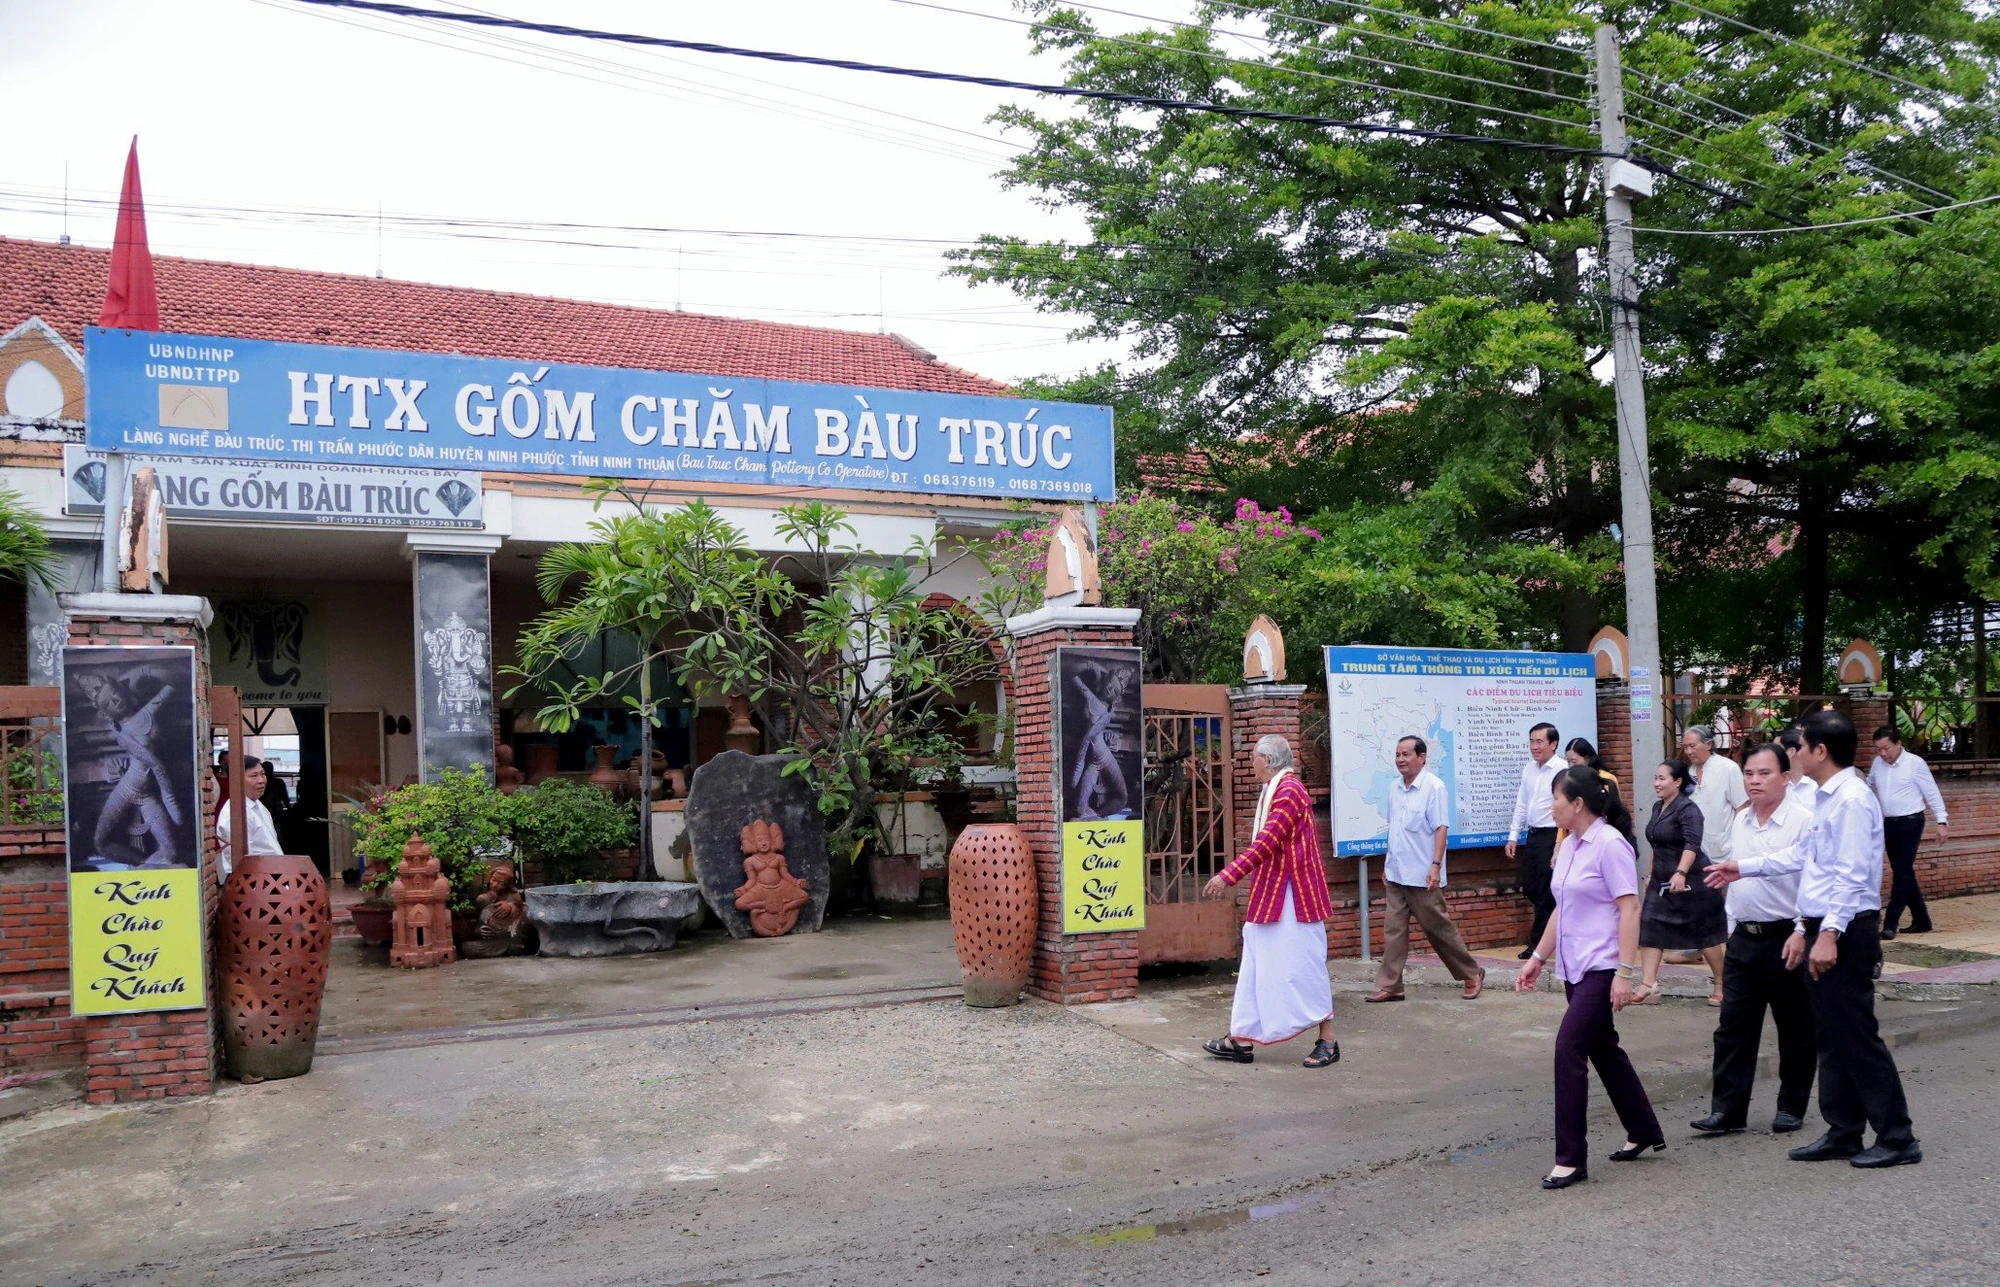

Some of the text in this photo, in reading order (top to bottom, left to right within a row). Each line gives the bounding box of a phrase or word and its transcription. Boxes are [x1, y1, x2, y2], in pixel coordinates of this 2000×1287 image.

[288, 367, 1073, 470] HTX GỐM CHĂM BÀU TRÚC
[123, 427, 163, 445] LÀNG
[168, 430, 209, 448] NGHỀ
[215, 431, 242, 449] BÀU
[318, 436, 353, 455] TRẤN
[358, 441, 403, 458] PHƯỚC
[487, 449, 517, 463] NINH
[603, 457, 631, 469] NINH
[636, 456, 674, 473] THUẬN
[734, 456, 767, 472] Cham
[219, 470, 289, 510] GỐM
[298, 476, 352, 513] BÀU
[360, 480, 430, 516] TRÚC
[1341, 662, 1587, 678] TRUNG TÂM THÔNG TIN XÚC TIẾN DU LỊCH
[1466, 687, 1483, 696] CÁC
[1509, 688, 1521, 696] DU
[1523, 688, 1542, 698] LỊCH
[1077, 829, 1126, 849] Kính
[1082, 854, 1121, 871] Chào
[94, 881, 173, 906] Kính
[1082, 878, 1118, 900] Quý
[101, 913, 164, 935] Chào
[1074, 904, 1134, 923] Khách
[103, 944, 160, 972] Quý
[90, 976, 187, 1001] Khách
